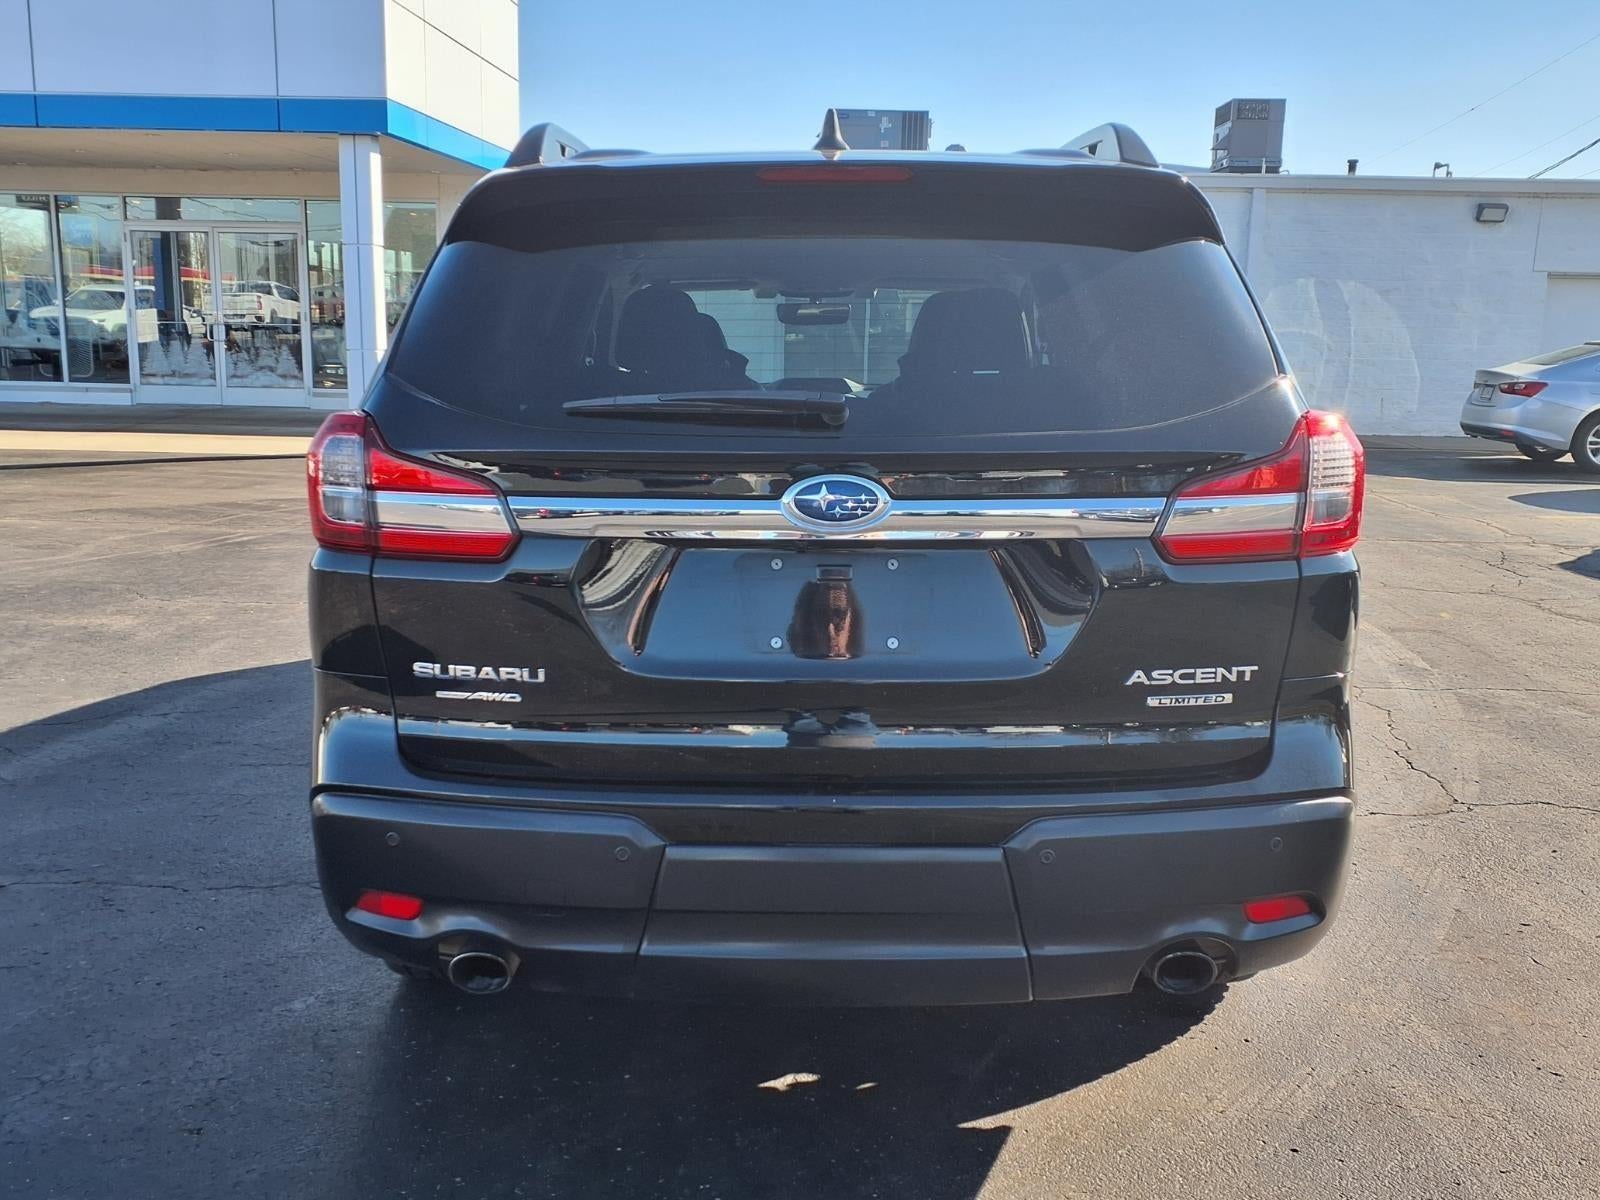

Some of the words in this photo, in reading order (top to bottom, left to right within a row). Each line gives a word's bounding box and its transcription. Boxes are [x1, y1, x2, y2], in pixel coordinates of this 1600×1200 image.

[412, 661, 546, 683] SUBARU
[1125, 665, 1259, 685] ASCENT
[467, 691, 522, 702] AWD
[1158, 695, 1226, 705] LIMITED
